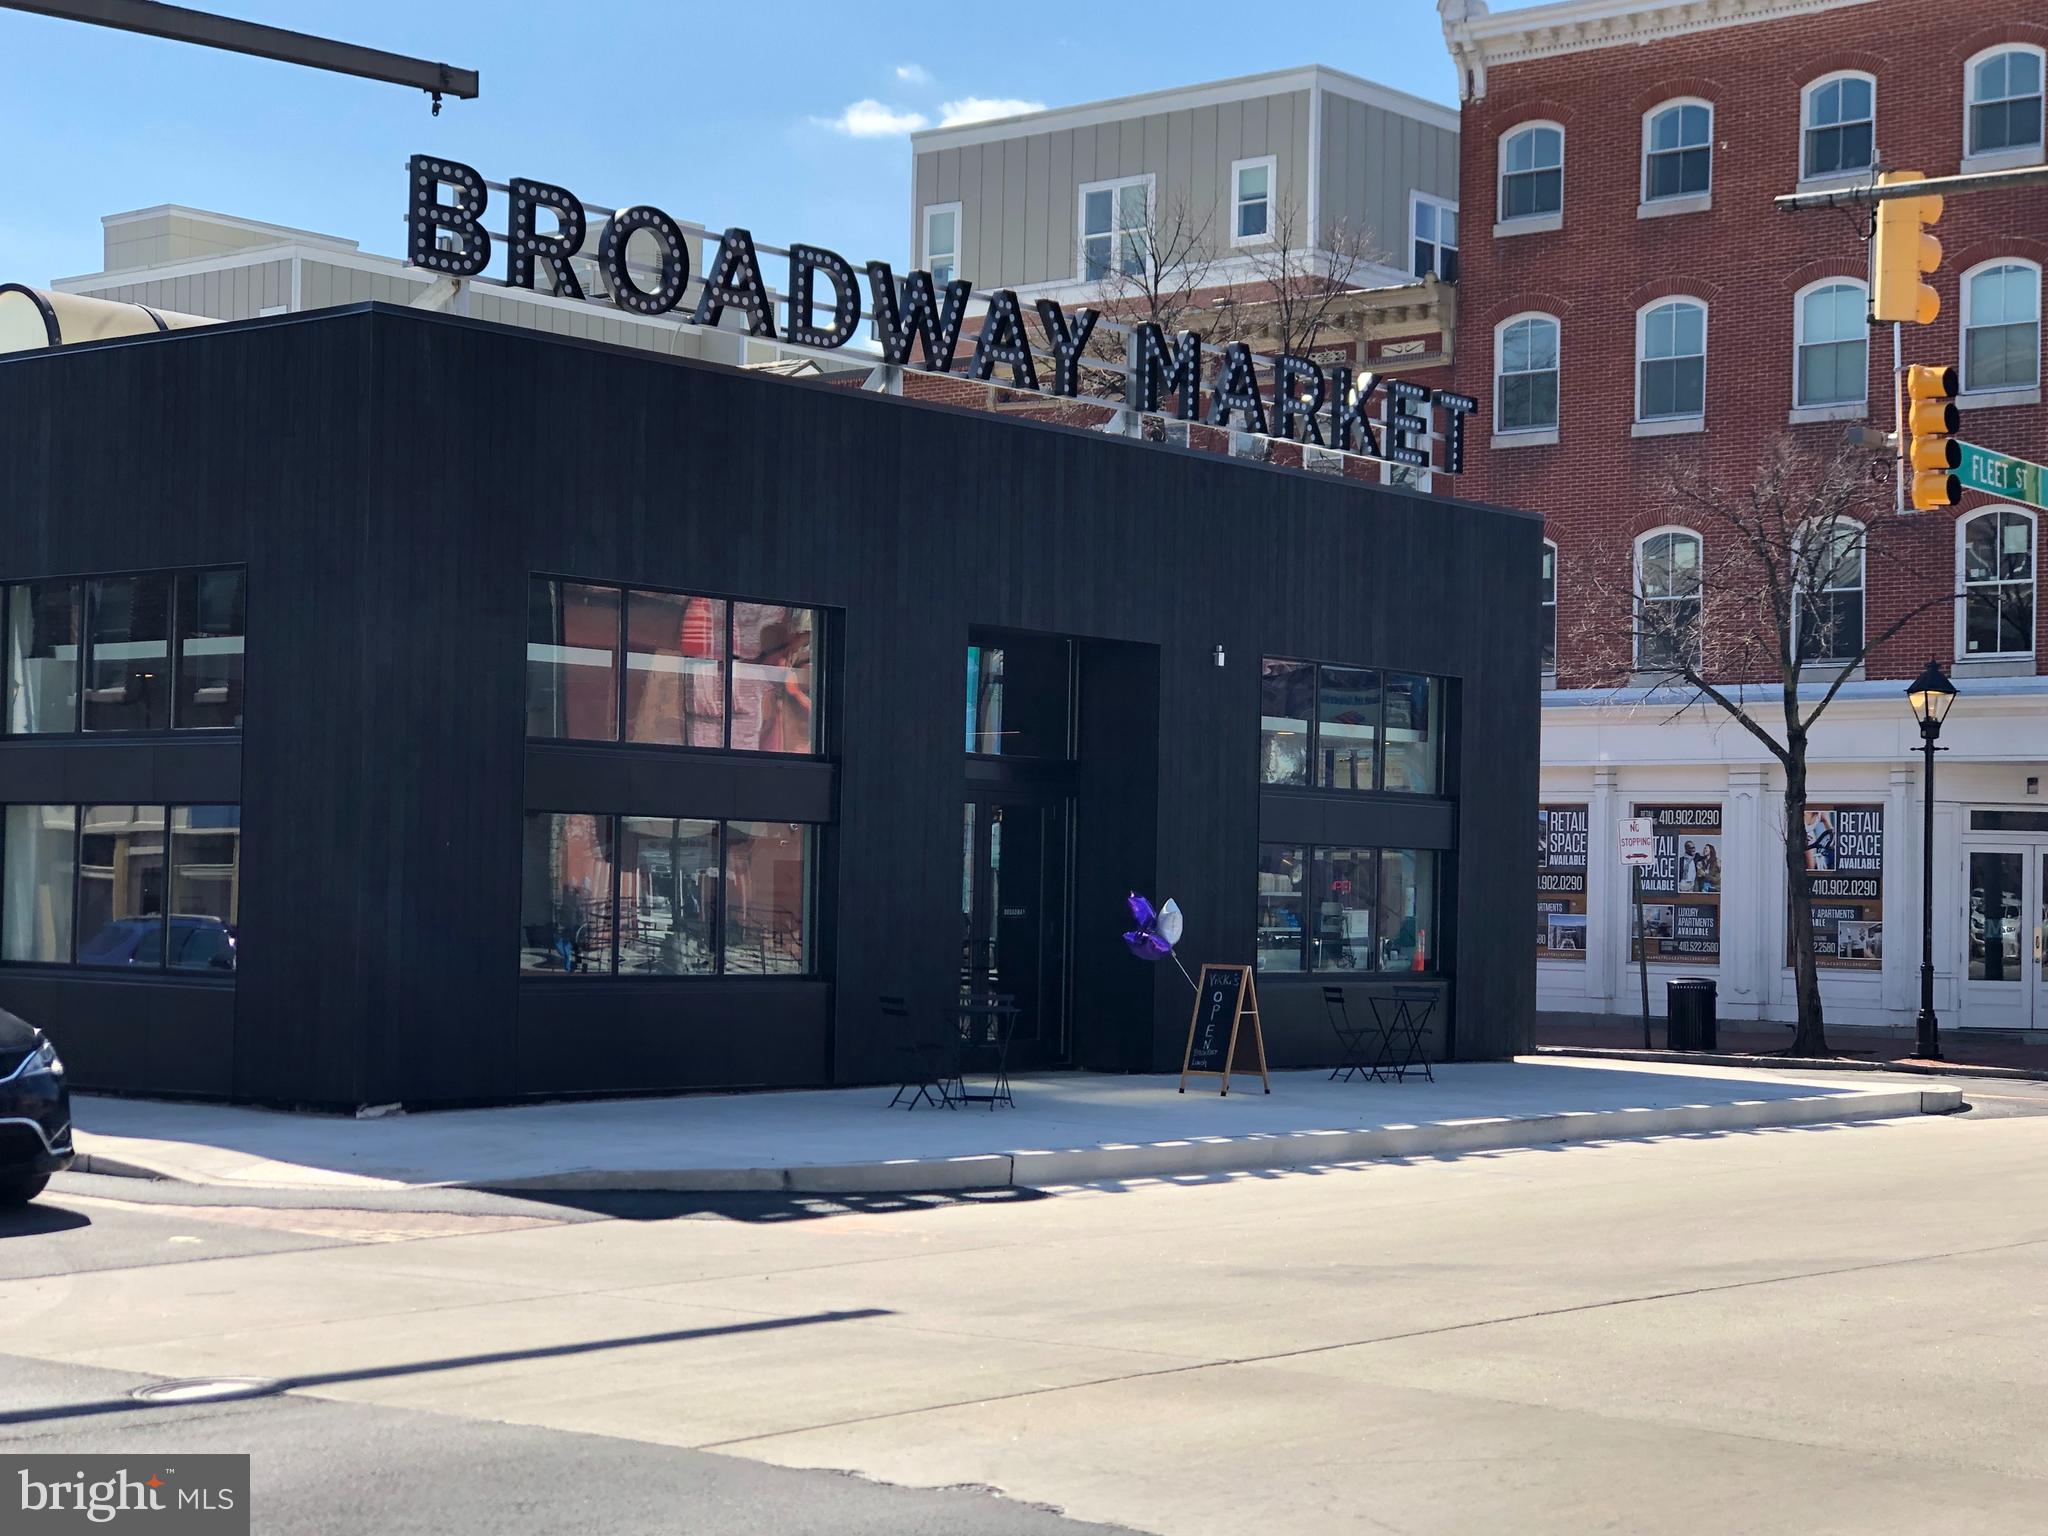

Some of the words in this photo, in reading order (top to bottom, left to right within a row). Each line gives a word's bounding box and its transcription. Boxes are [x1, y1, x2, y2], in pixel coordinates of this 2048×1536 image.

[408, 153, 1100, 397] BROADWAY
[1135, 321, 1477, 473] MARKET
[1972, 455, 2008, 488] FLEET
[2015, 467, 2028, 490] ST
[1550, 811, 1587, 832] RETAIL
[1659, 809, 1719, 825] 410.902.0290
[1840, 812, 1882, 833] RETAIL
[1550, 833, 1586, 853] SPACE
[1621, 837, 1651, 847] STOPPING
[1653, 836, 1676, 856] TAIL
[1840, 834, 1880, 856] SPACE
[1549, 854, 1586, 866] AVAILABLE
[1839, 858, 1880, 870] AVAILABLE
[1538, 875, 1583, 890] .902.0290
[1641, 879, 1675, 891] VAILABLE
[1812, 879, 1877, 896] 410.902.0290
[1817, 909, 1855, 919] APARTMENTS
[1677, 918, 1714, 928] APARTMENTS
[1677, 927, 1709, 936] AVAILABLE
[1203, 991, 1223, 1050] OPEN
